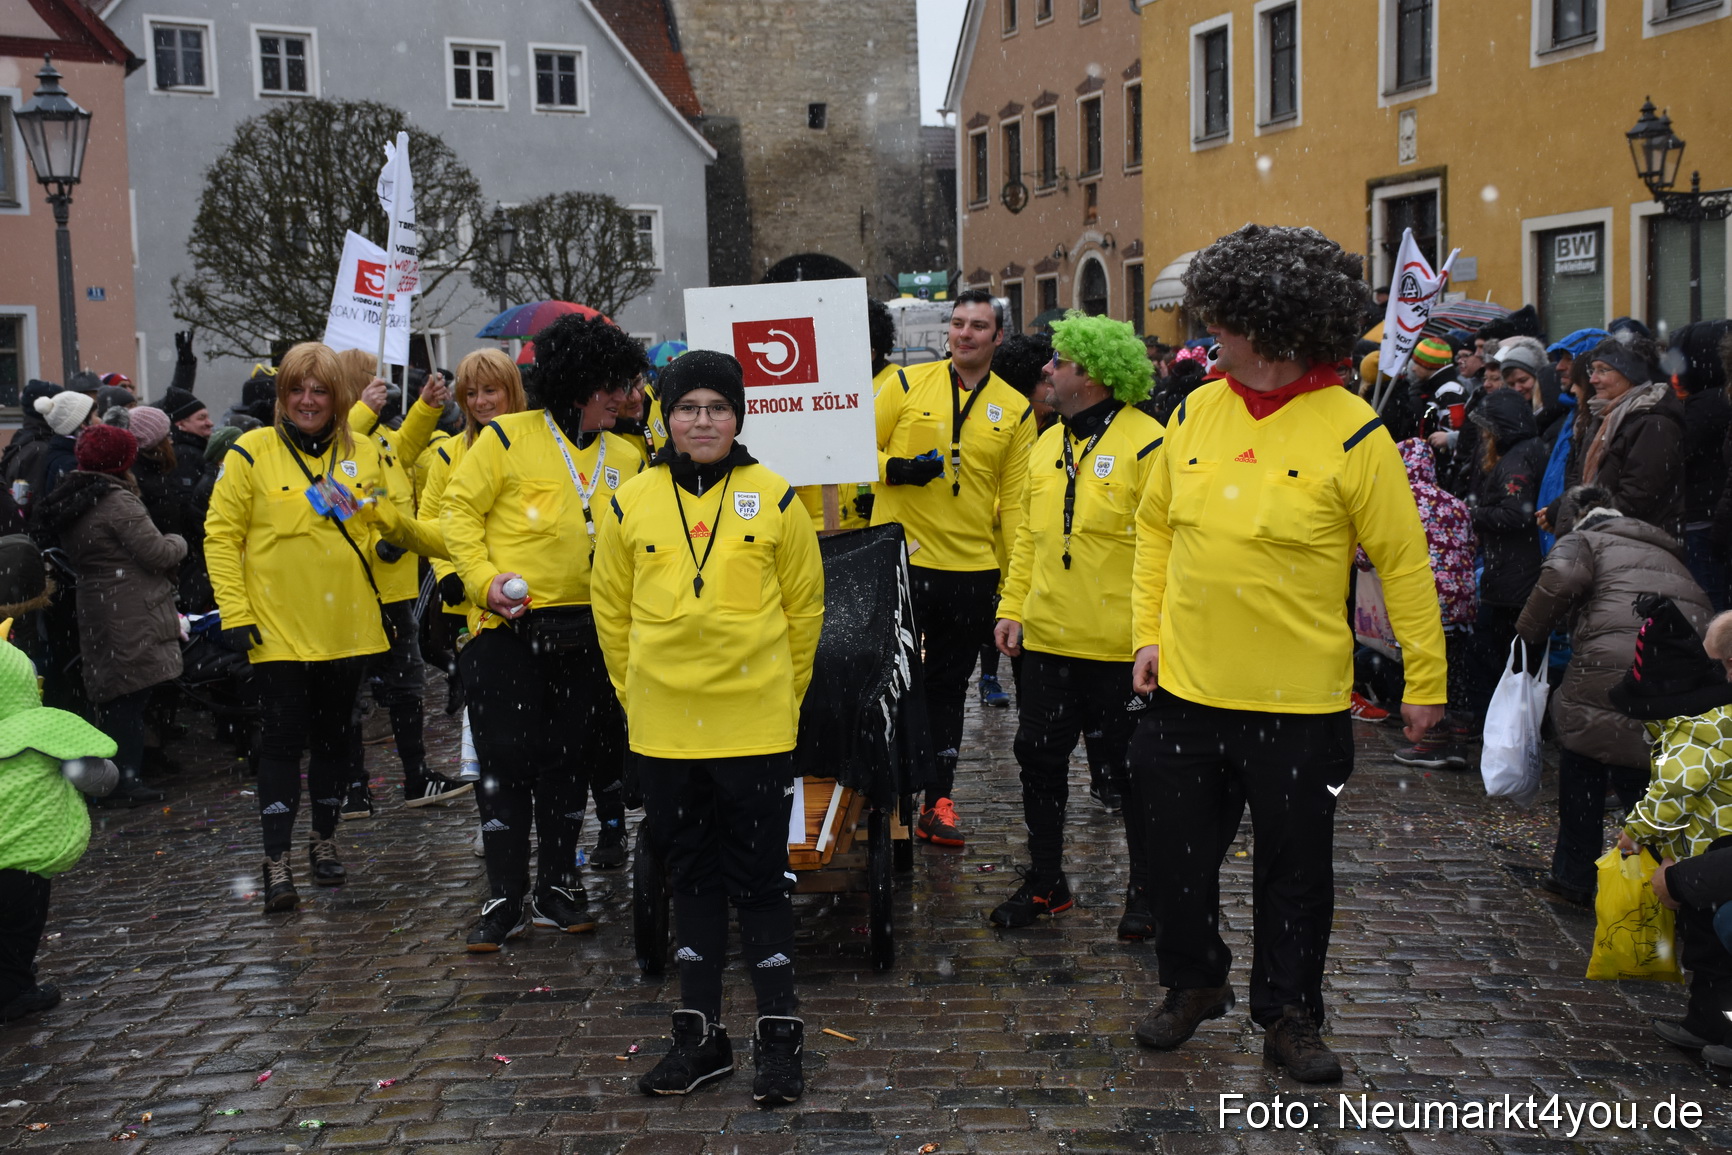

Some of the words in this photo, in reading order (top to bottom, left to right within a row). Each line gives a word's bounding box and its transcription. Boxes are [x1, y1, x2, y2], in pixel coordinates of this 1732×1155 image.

[1557, 234, 1593, 258] BW
[353, 296, 372, 305] VIDEO
[746, 396, 804, 415] KROOM
[811, 391, 859, 412] KÖLN
[1126, 703, 1146, 711] adidas
[756, 959, 791, 968] adidas
